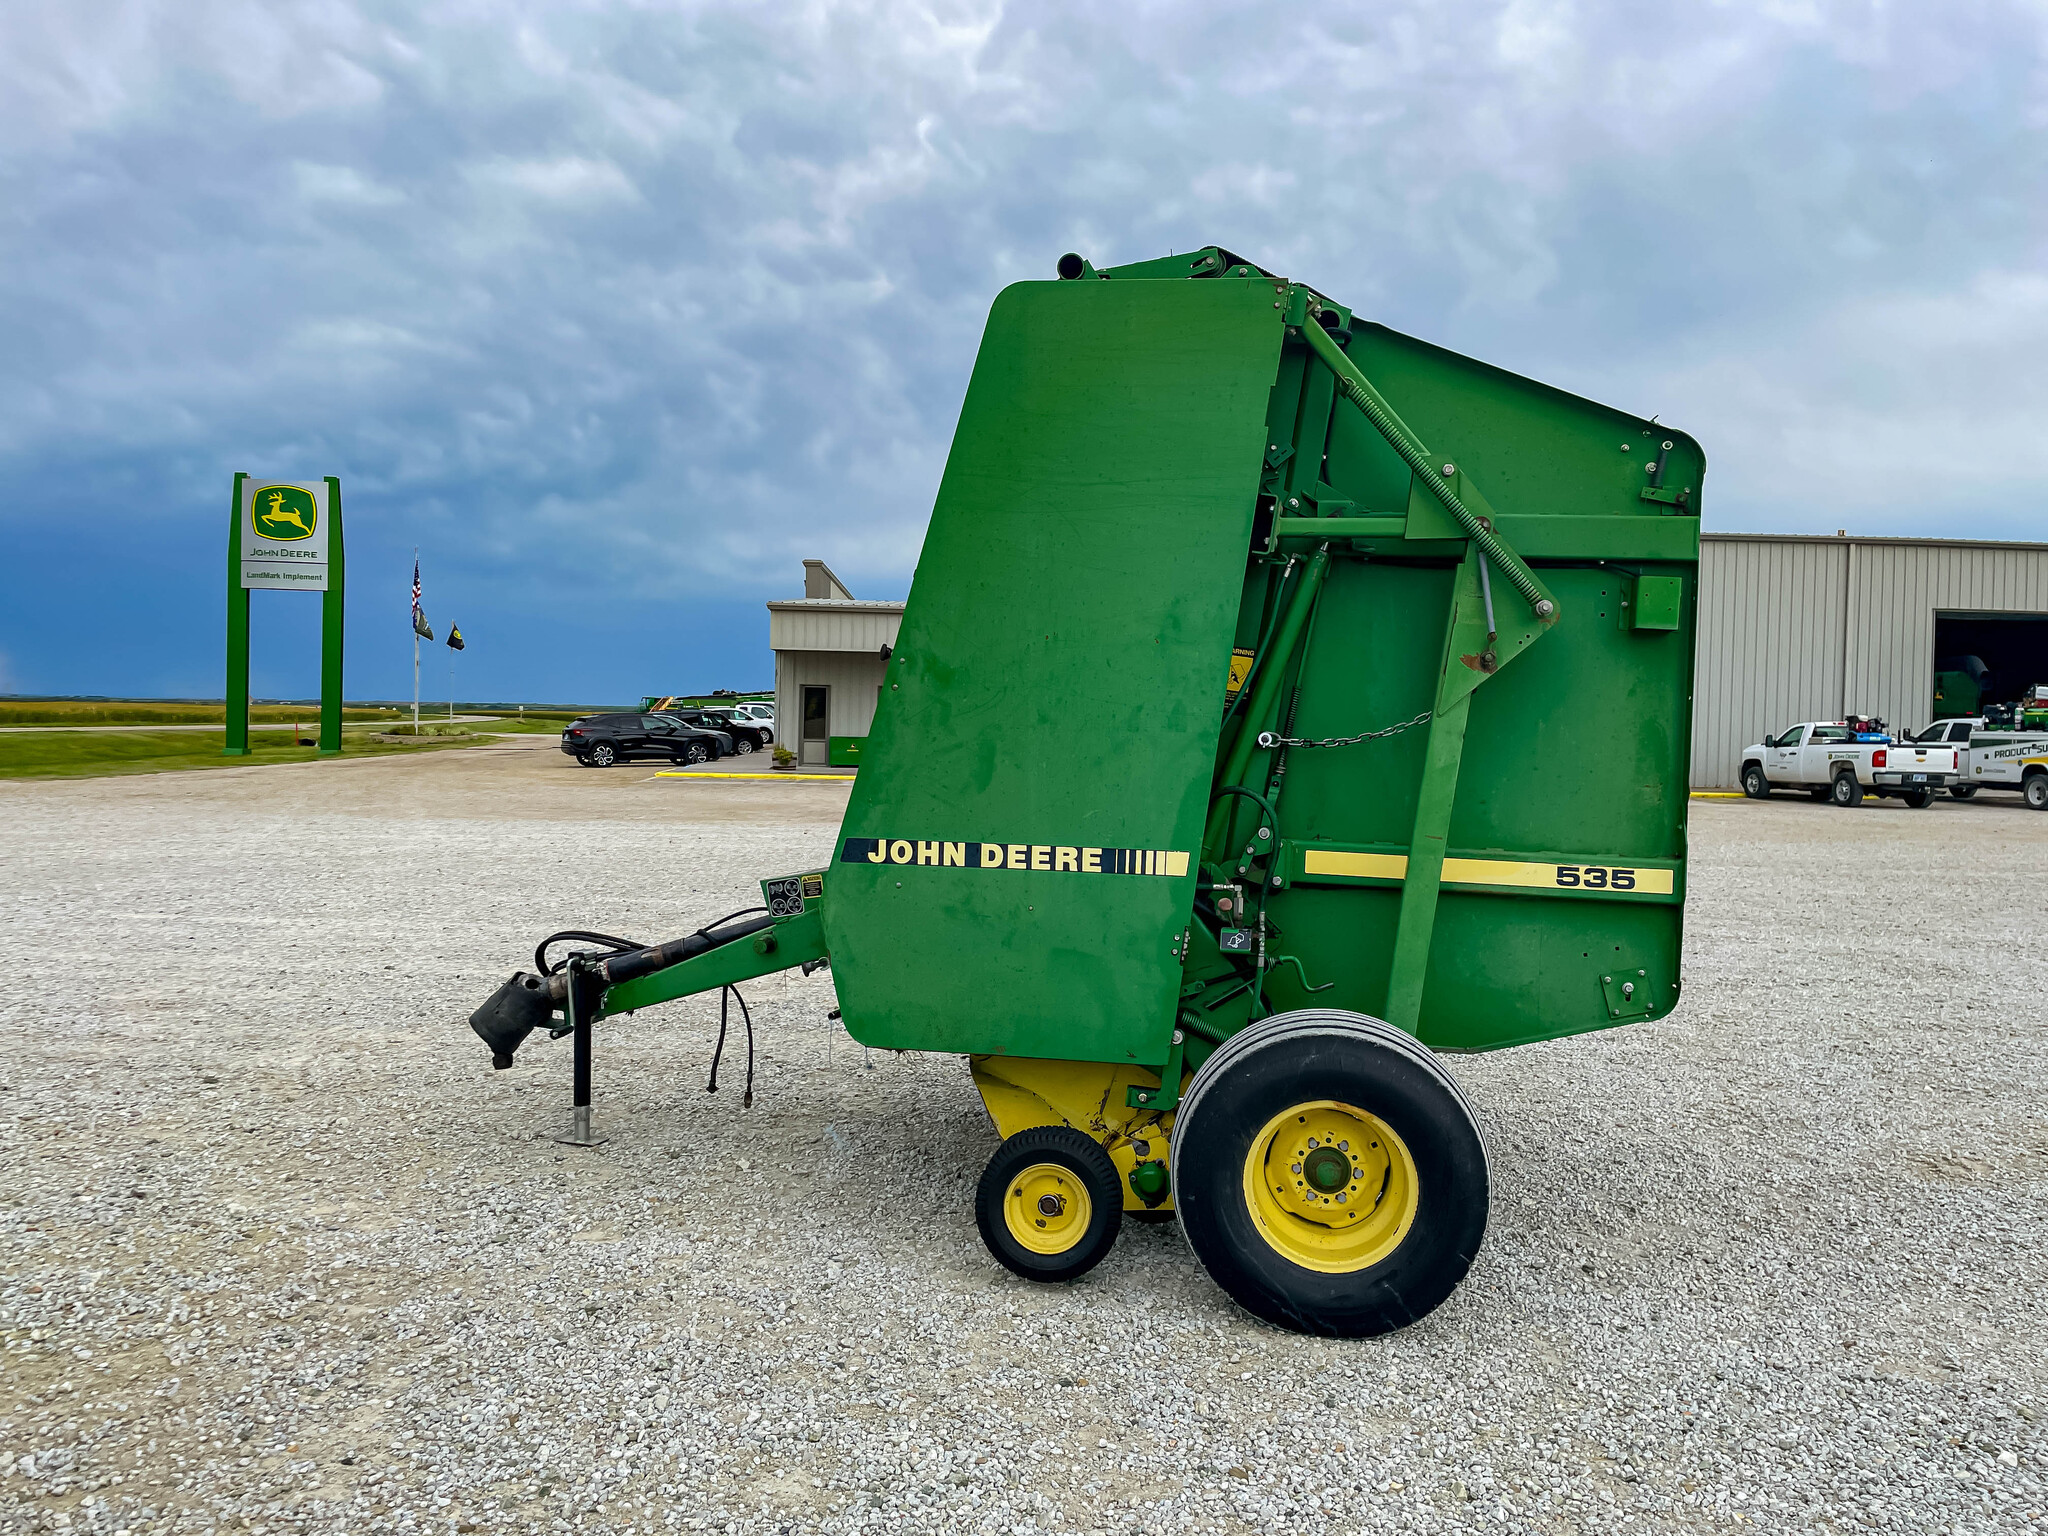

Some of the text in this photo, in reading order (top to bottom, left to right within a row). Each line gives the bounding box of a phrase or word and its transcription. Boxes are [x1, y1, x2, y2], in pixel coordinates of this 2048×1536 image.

[250, 548, 318, 559] JOHN DEERE
[283, 573, 322, 581] Implement
[1994, 747, 2032, 759] PRODUCT
[867, 838, 1103, 873] JOHN DEERE
[1556, 866, 1635, 889] 535
